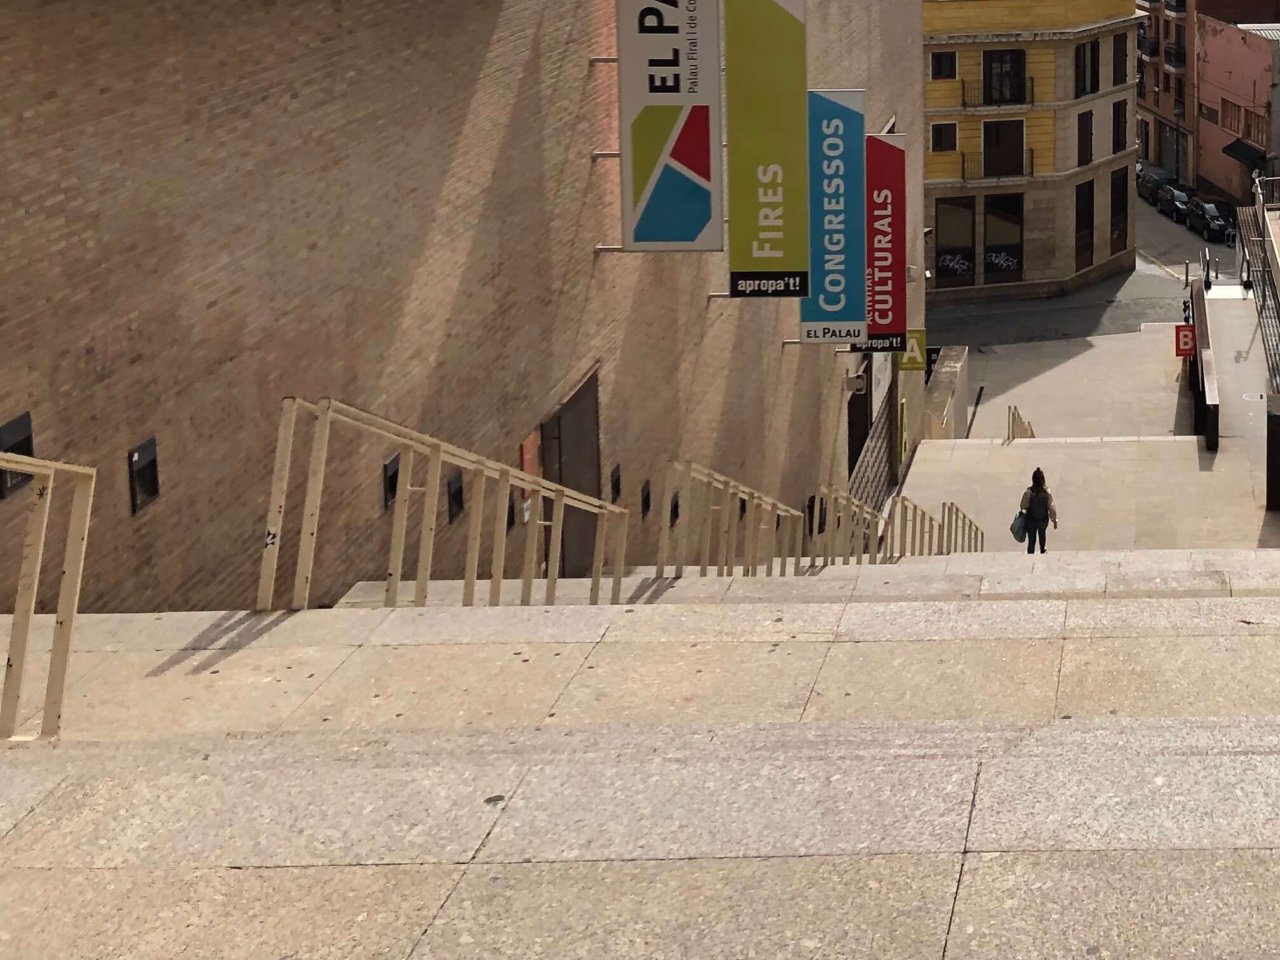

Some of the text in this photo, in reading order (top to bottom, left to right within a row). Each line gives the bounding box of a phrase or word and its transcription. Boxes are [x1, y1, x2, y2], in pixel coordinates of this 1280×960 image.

[686, 15, 698, 29] de
[686, 38, 698, 61] Firal
[648, 47, 681, 94] EL
[686, 64, 699, 94] Palau
[752, 162, 784, 258] FIRES
[818, 117, 847, 313] CONGRESSOS
[873, 188, 893, 325] CULTURALS
[737, 277, 800, 293] apropa't!
[806, 327, 861, 339] EL PALAU
[1179, 330, 1193, 350] B
[902, 338, 923, 363] A
